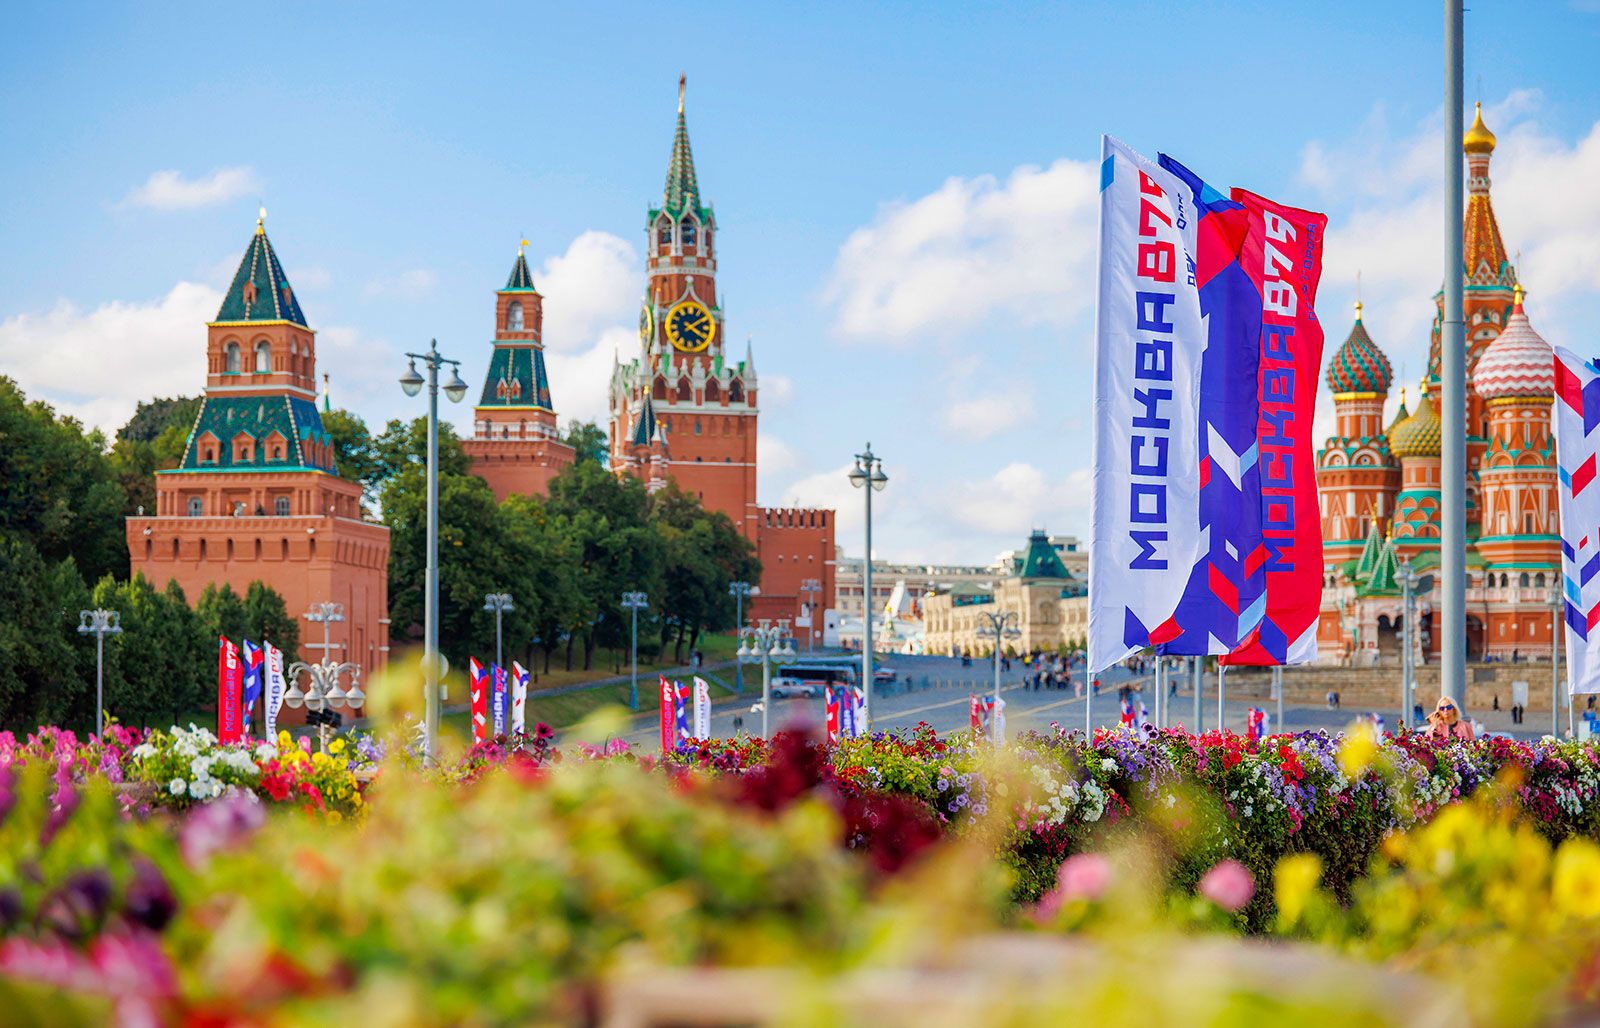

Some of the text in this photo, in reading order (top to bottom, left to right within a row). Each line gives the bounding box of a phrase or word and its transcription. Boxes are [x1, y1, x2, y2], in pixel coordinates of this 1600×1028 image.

[1129, 291, 1176, 570] МОСКВА
[1260, 209, 1298, 572] МОСКВА 879
